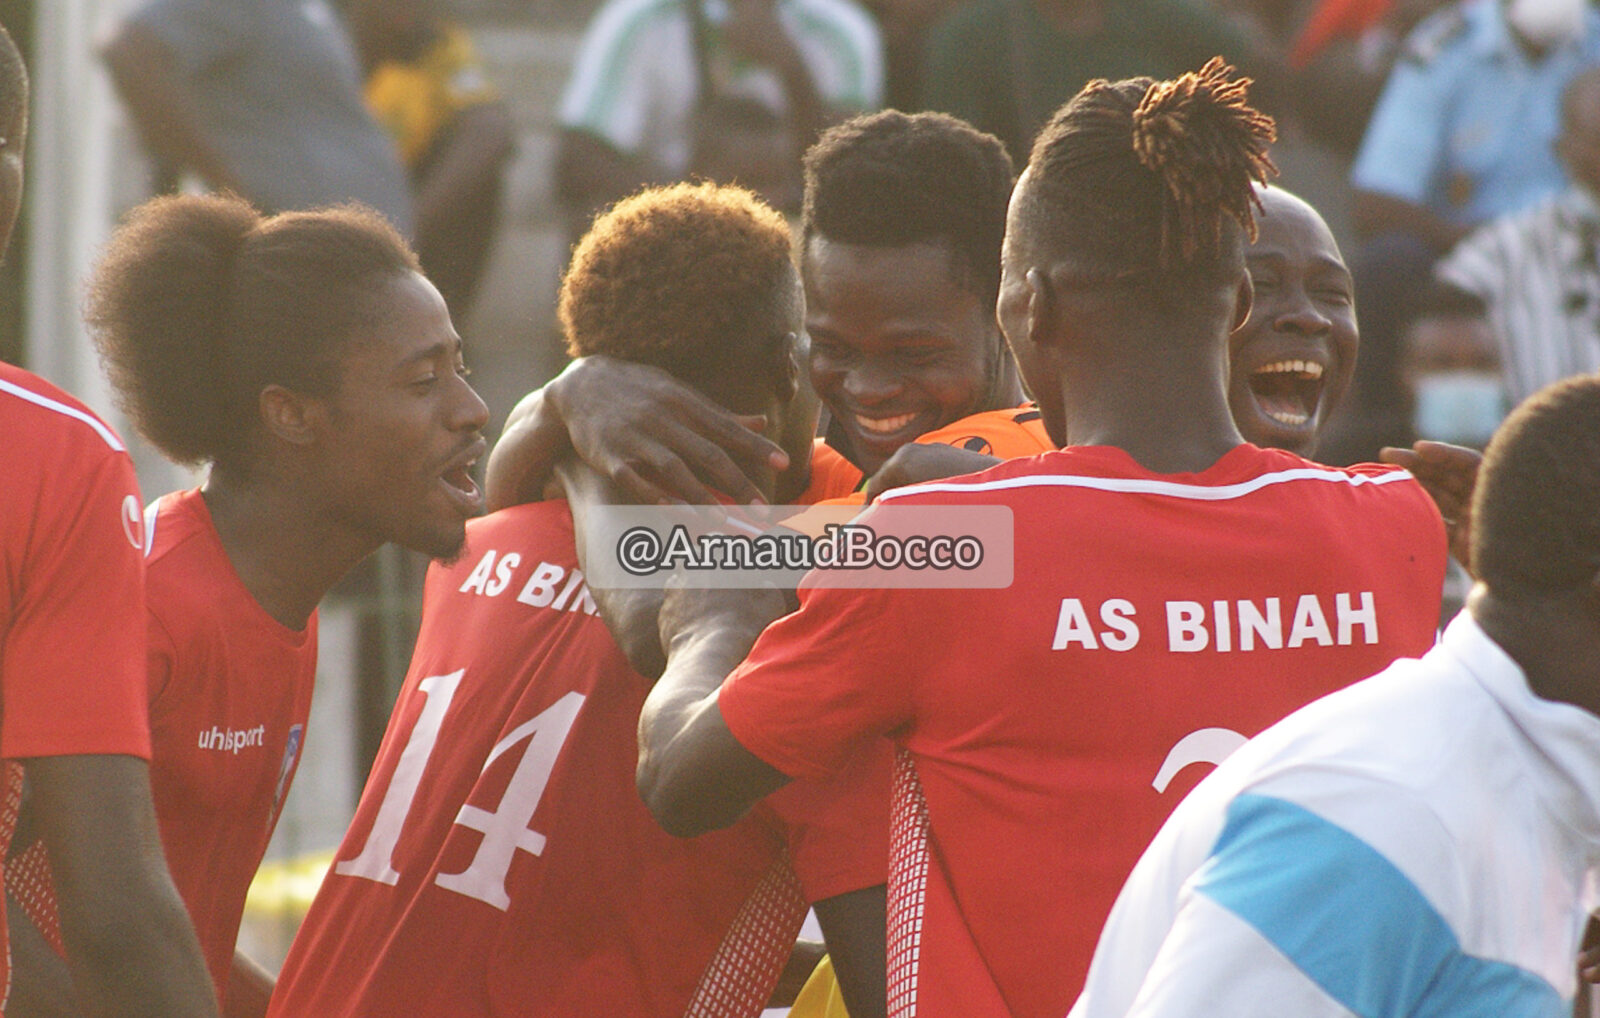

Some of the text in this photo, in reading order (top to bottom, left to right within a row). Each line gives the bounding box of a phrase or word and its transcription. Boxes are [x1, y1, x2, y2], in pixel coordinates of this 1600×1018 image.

[459, 550, 601, 617] AS BIN
[1052, 592, 1379, 652] AS BINAH
[198, 724, 265, 755] uhlsport
[335, 668, 587, 912] 14
